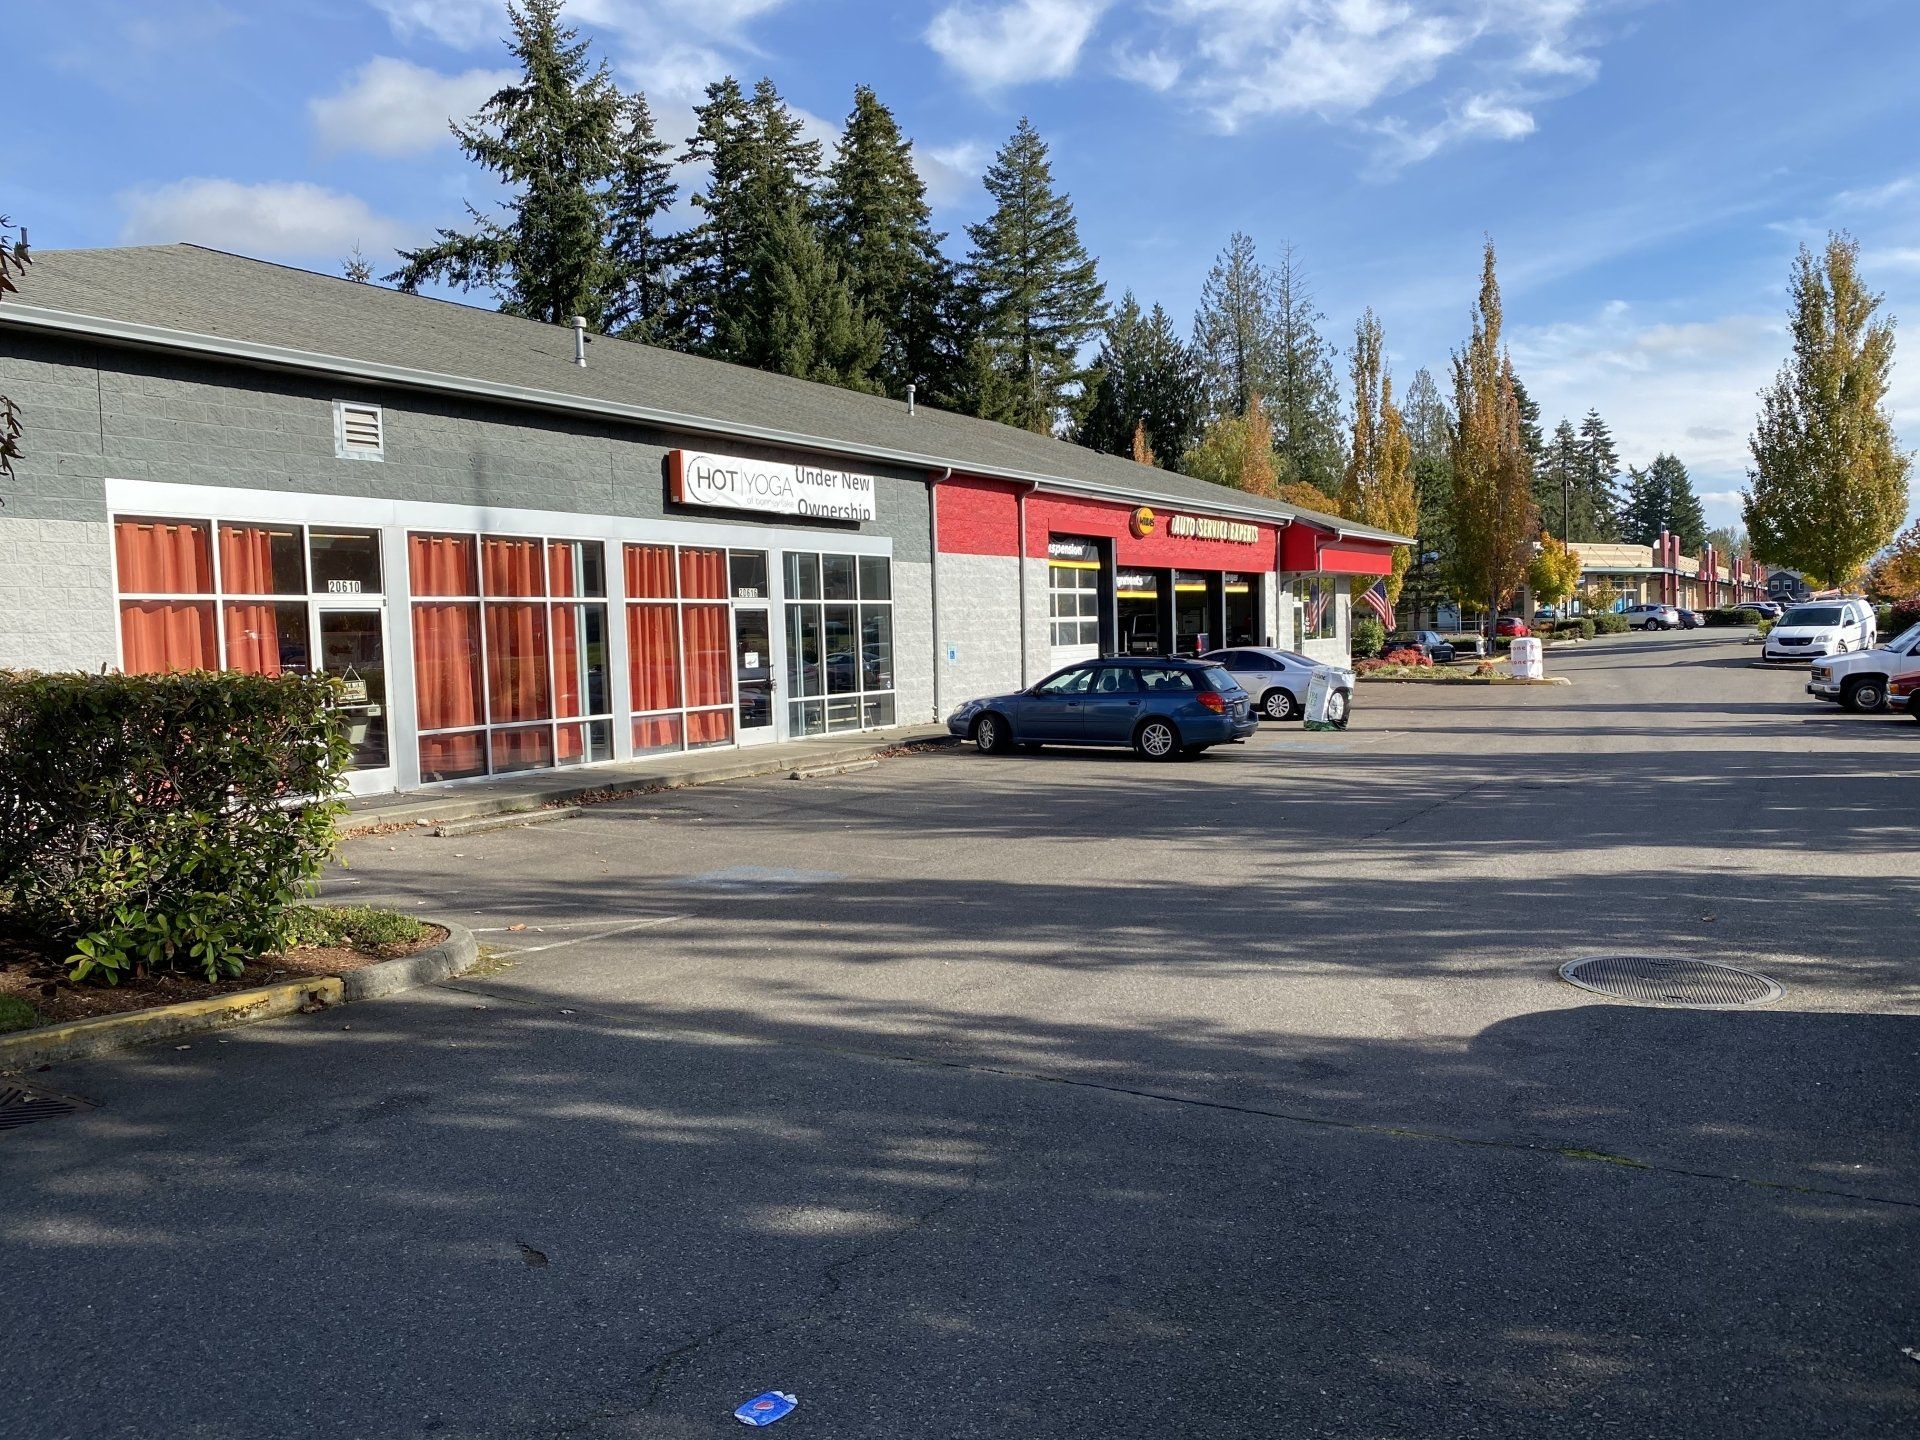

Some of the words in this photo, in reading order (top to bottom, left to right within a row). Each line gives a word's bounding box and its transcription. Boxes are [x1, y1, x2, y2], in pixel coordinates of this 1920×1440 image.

[697, 466, 738, 491] HOT
[743, 472, 794, 497] YOGA
[795, 465, 837, 487] Under
[842, 472, 870, 491] New
[797, 498, 871, 521] Ownership
[1171, 514, 1196, 536] AUTO
[1196, 518, 1228, 539] SERVICE
[1228, 521, 1259, 543] EXPERTS
[329, 581, 360, 593] 20610
